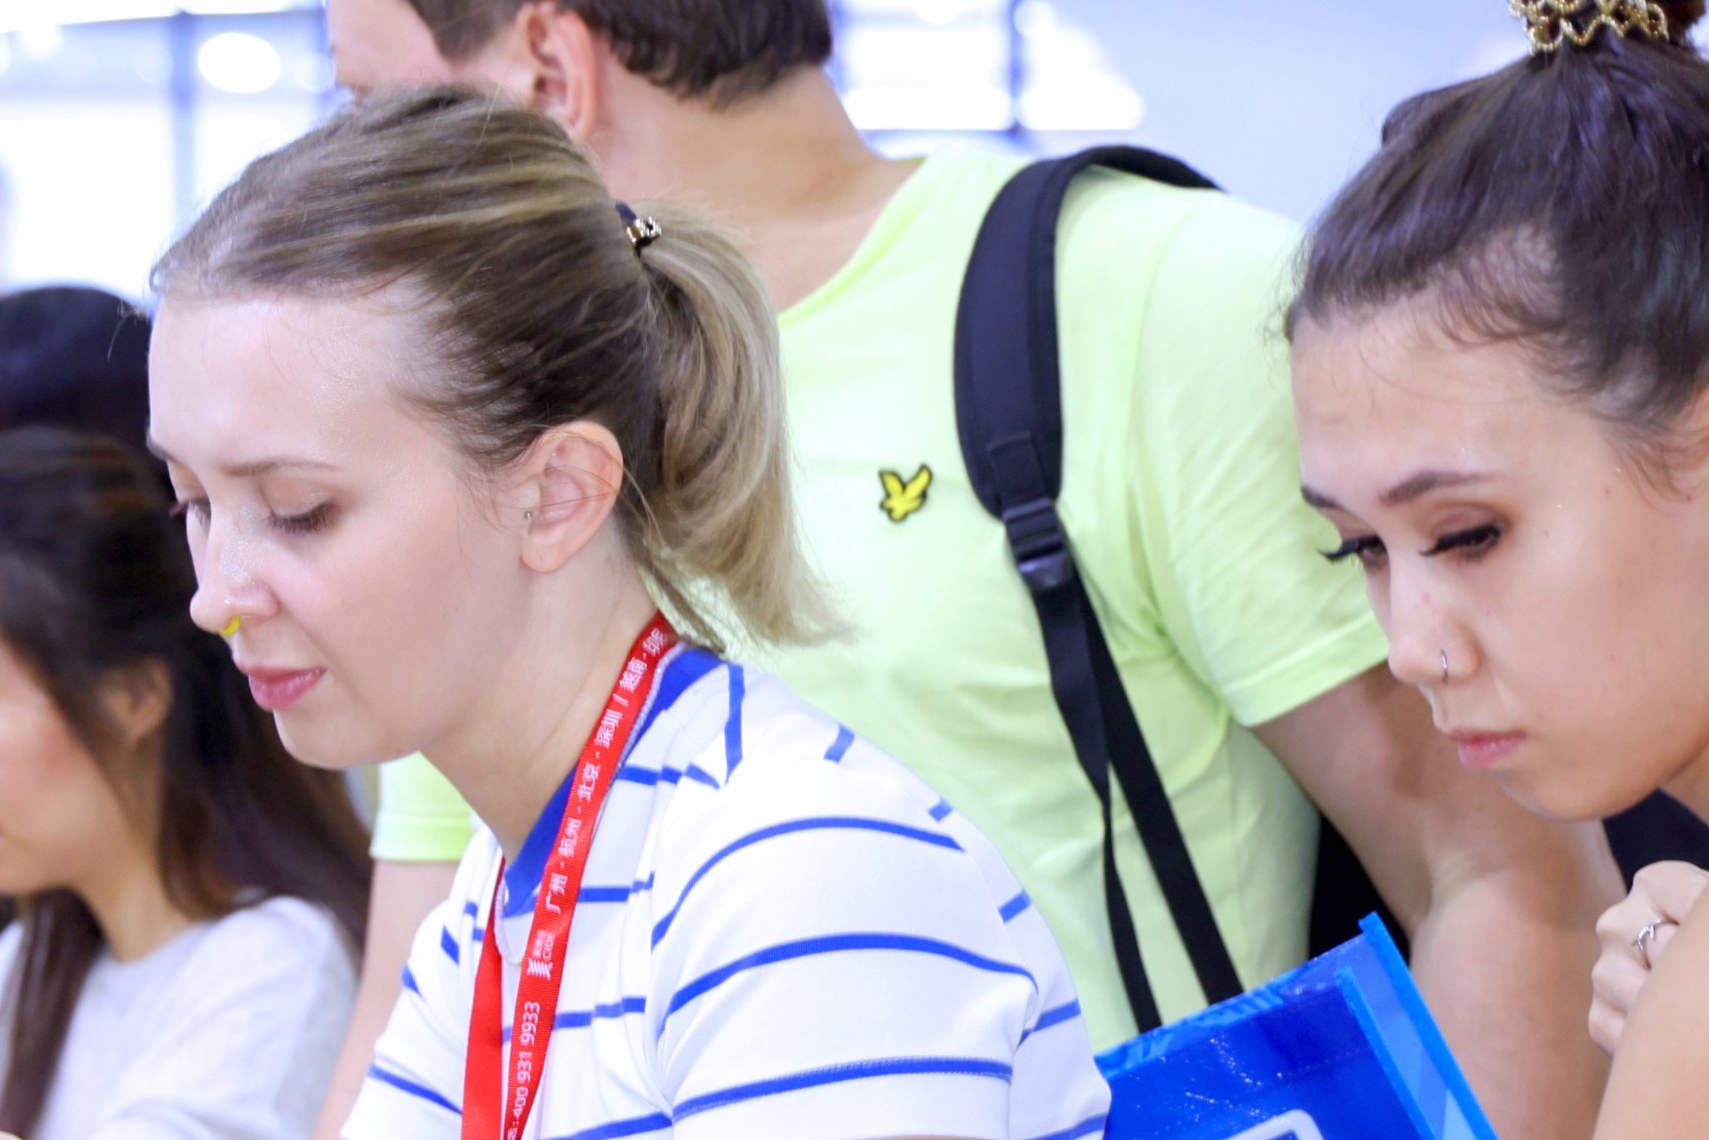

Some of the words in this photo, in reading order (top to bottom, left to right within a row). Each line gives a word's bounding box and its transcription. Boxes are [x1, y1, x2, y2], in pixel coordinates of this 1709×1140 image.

[520, 1000, 541, 1046] 9933
[516, 1050, 533, 1084] 931
[512, 1086, 529, 1118] 400
